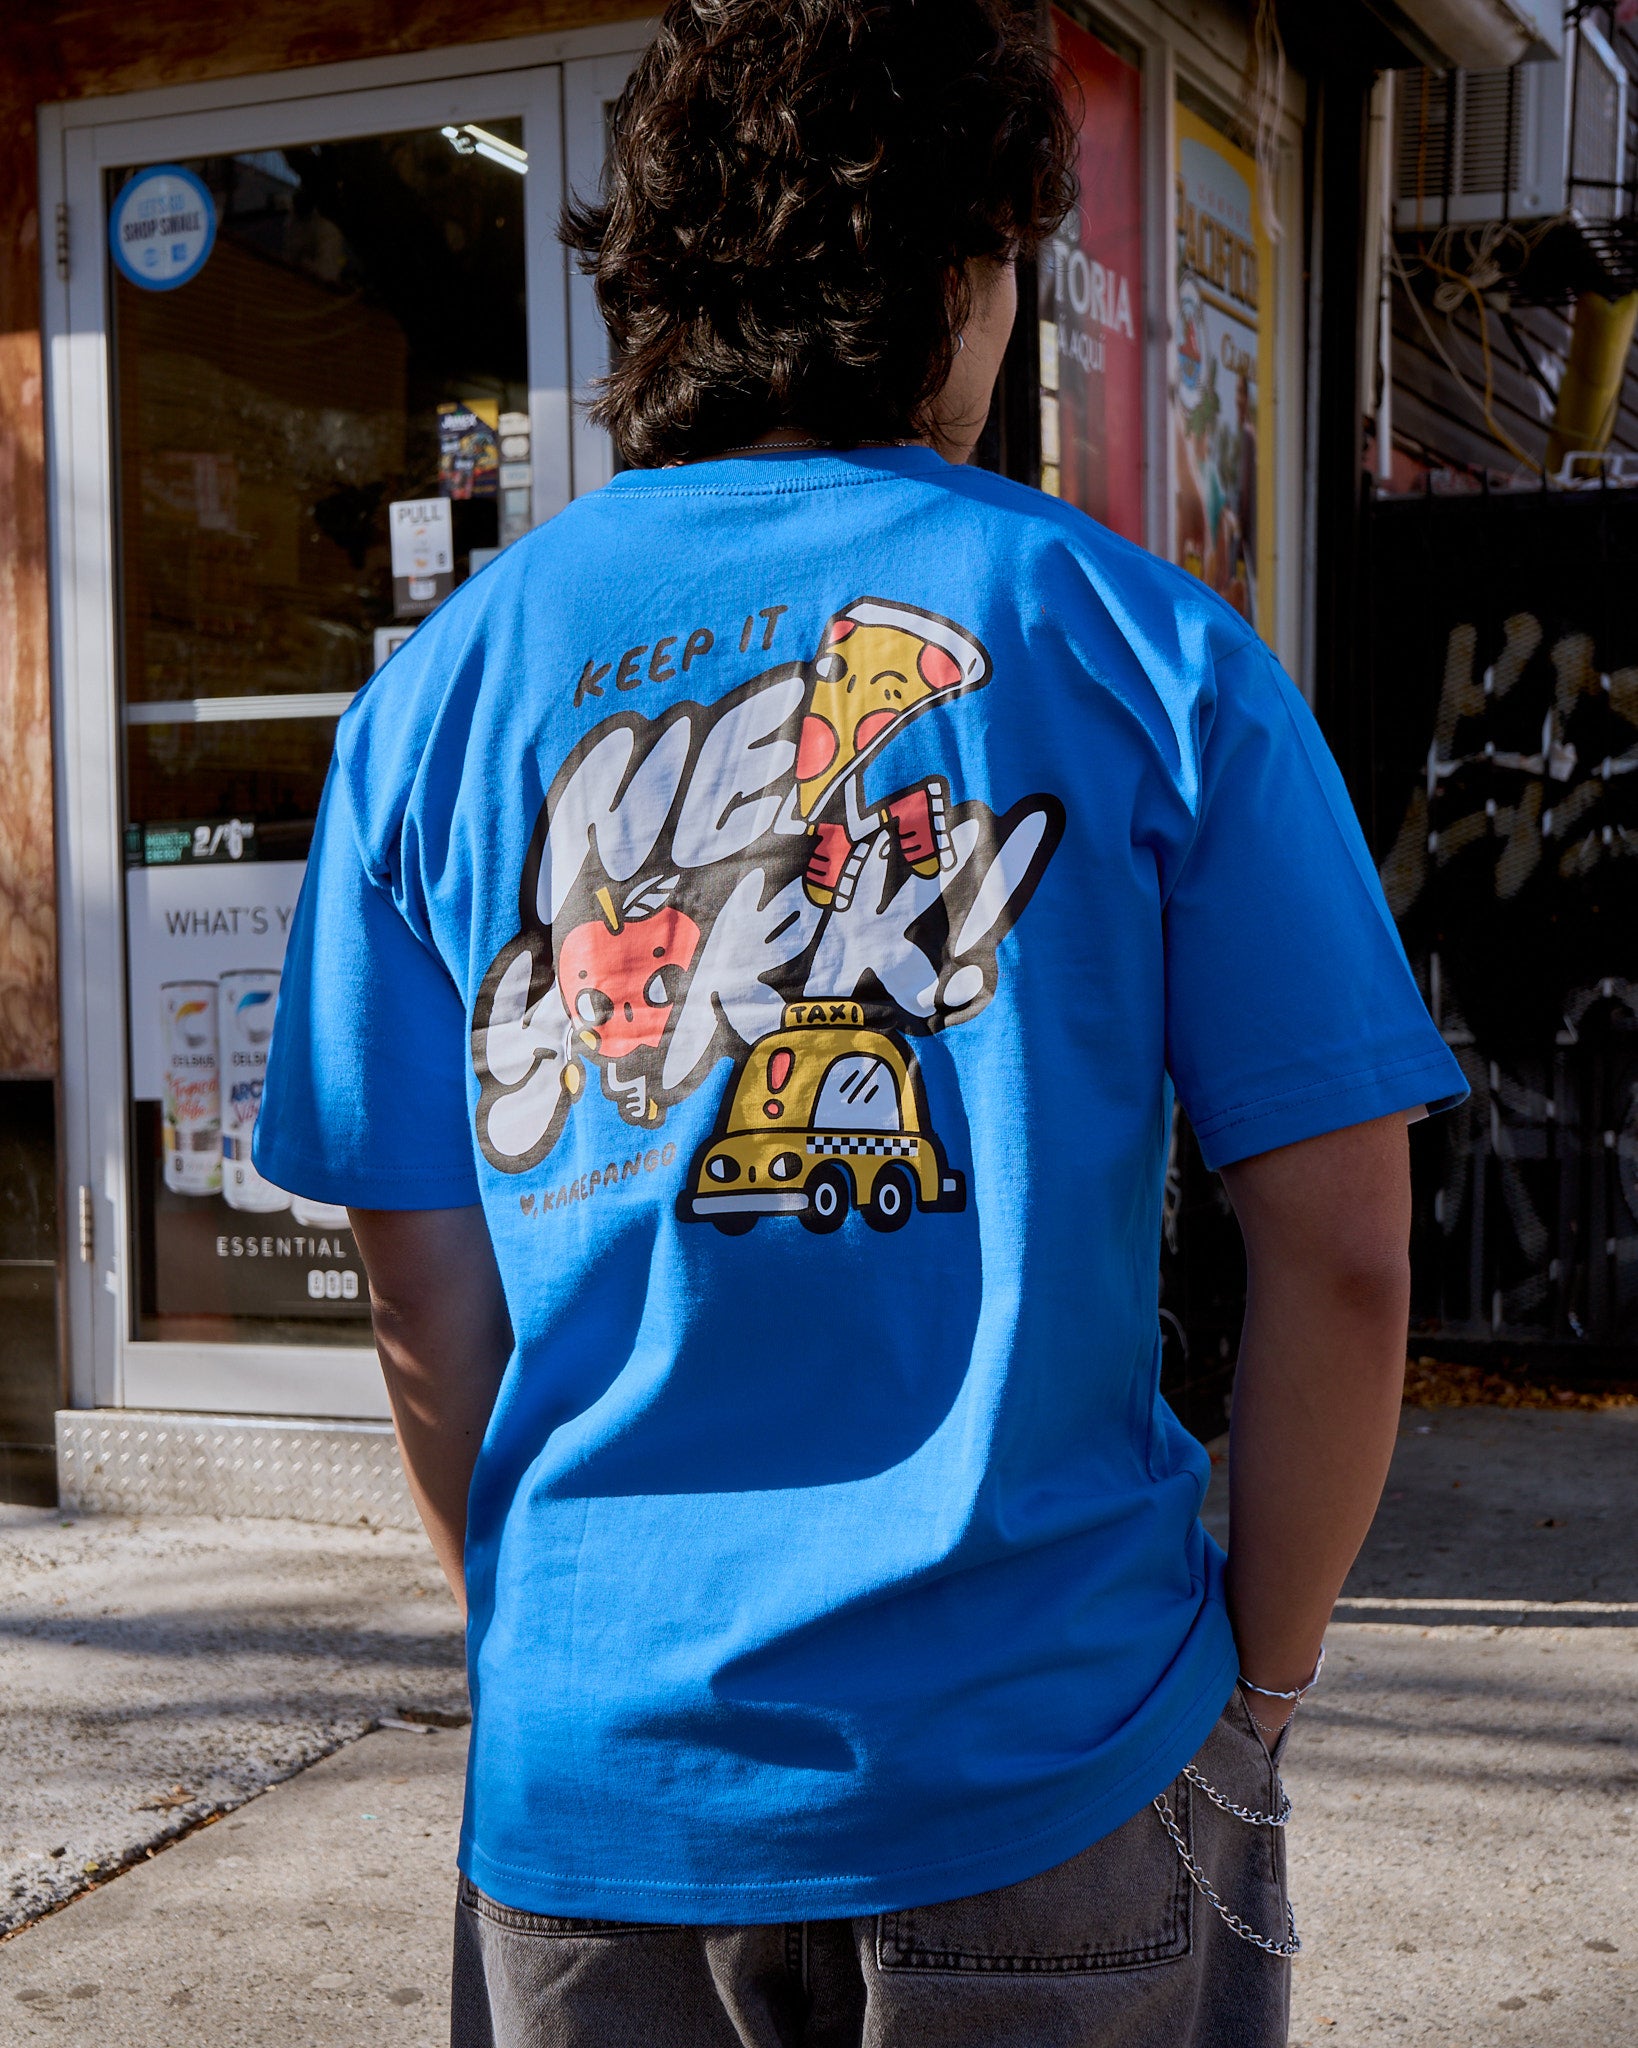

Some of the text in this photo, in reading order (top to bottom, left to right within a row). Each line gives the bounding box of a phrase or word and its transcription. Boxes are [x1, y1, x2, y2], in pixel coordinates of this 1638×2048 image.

[123, 211, 199, 242] SHOP SMALL
[1052, 238, 1135, 340] TORIA
[398, 503, 443, 523] PULL
[572, 603, 789, 708] KEEP IT
[145, 832, 191, 848] MONSTER
[145, 848, 183, 863] ENERGY
[166, 906, 269, 937] WHAT'S
[485, 810, 1048, 1157] YRK!
[790, 1003, 859, 1023] TAXI
[172, 1053, 216, 1068] CELSIUS
[232, 1051, 267, 1068] CELSI
[216, 1235, 348, 1259] ESSENTIAL
